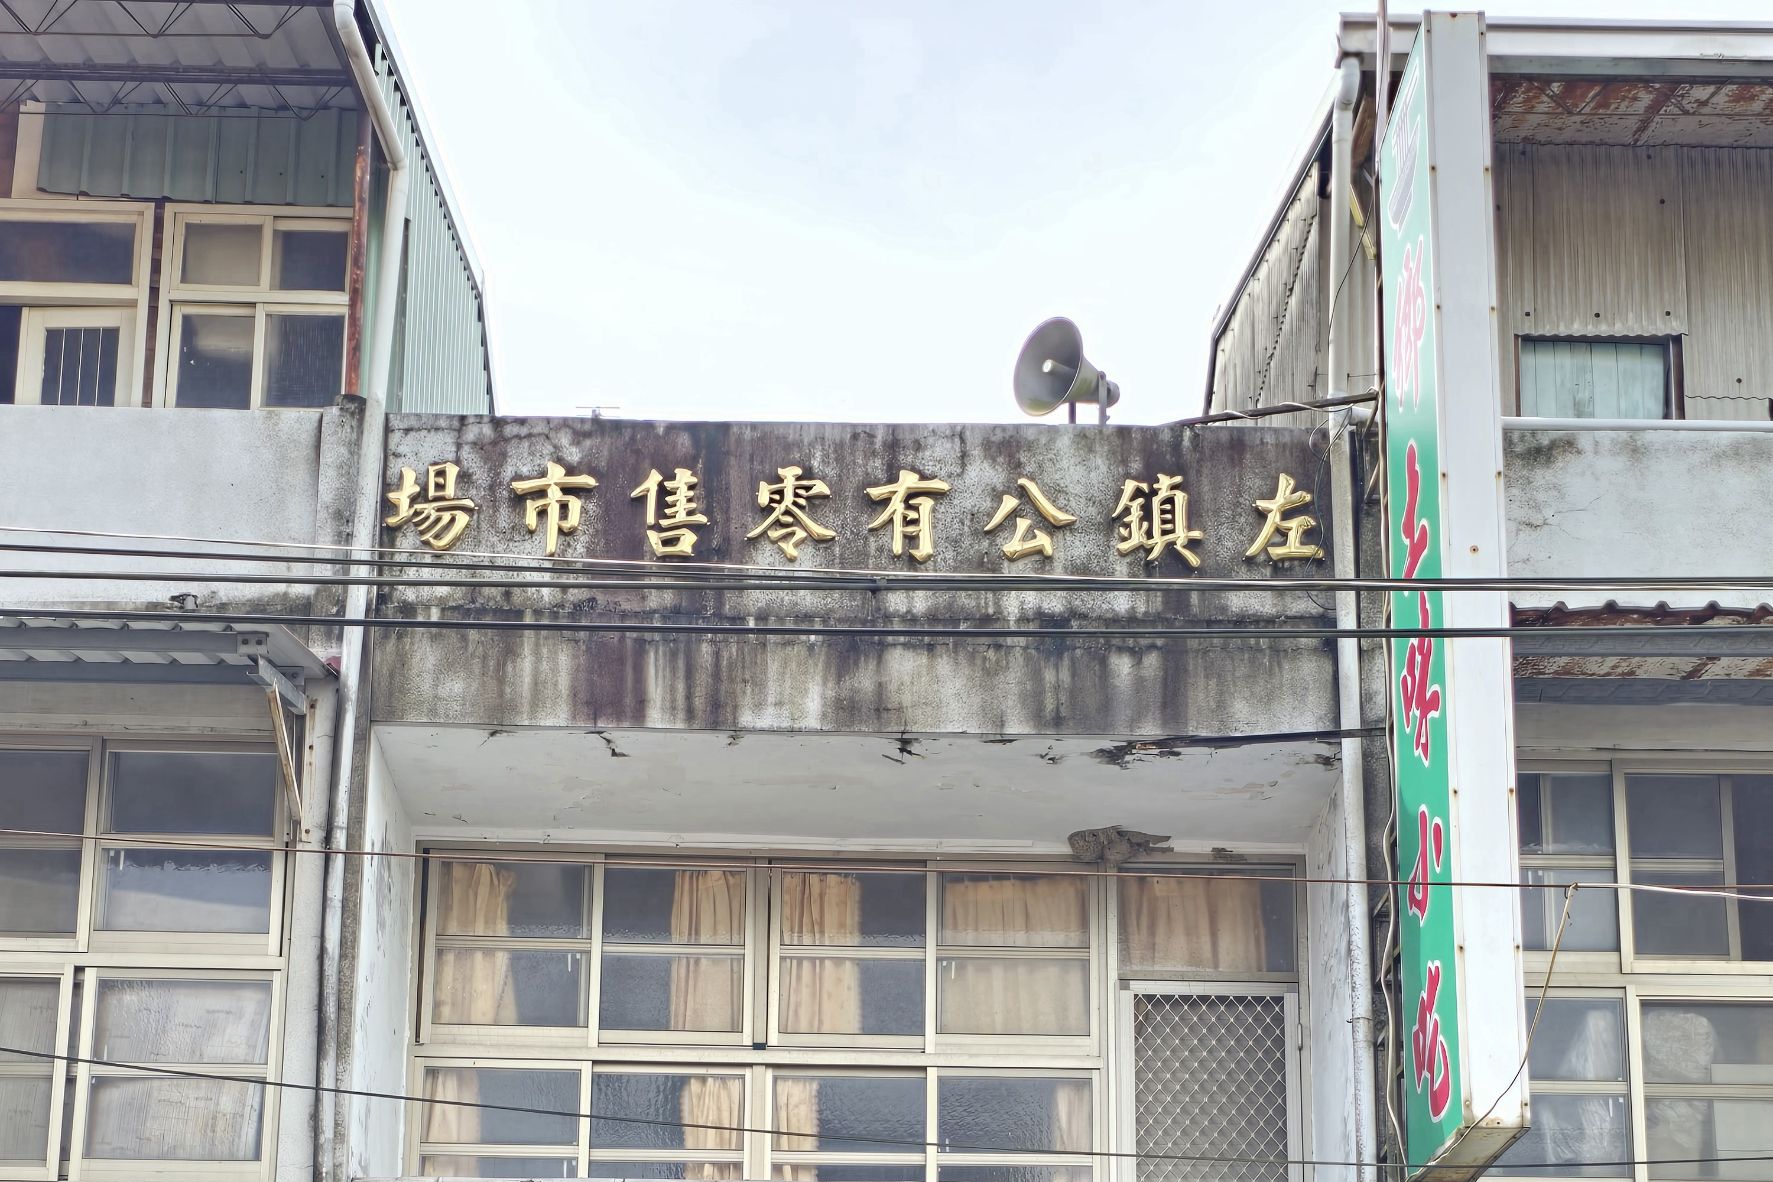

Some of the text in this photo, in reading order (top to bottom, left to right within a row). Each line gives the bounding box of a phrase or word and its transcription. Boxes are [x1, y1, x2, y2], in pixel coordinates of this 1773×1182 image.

[384, 461, 1326, 567] 左鎮公有零售市場
